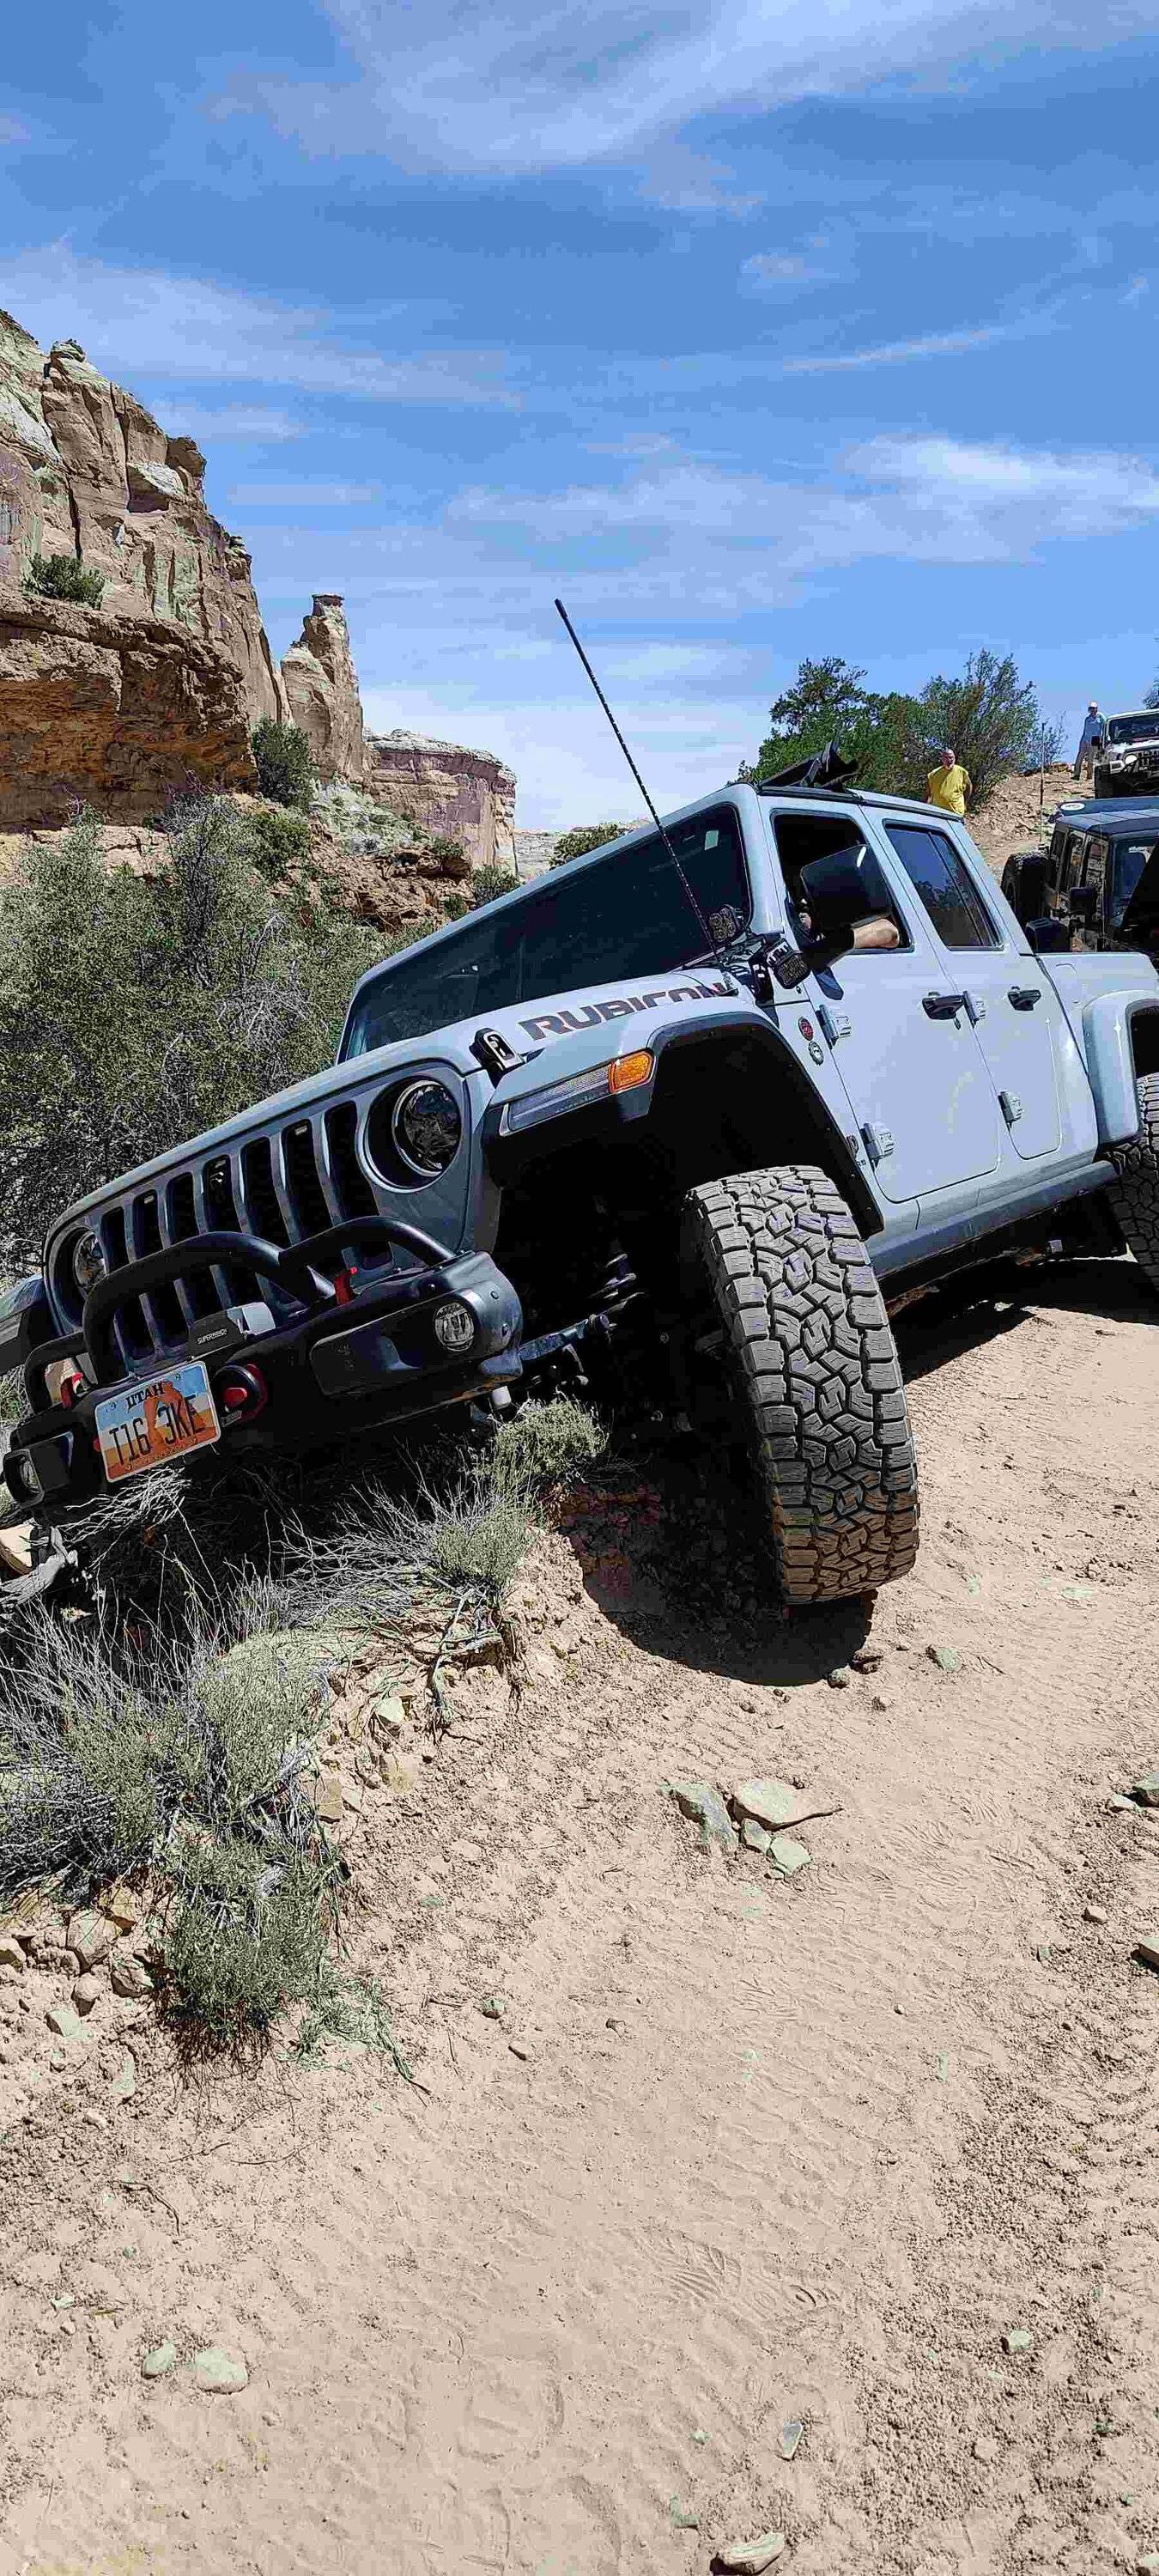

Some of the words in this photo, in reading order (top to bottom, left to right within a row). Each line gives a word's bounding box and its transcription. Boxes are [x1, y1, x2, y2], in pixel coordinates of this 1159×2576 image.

[518, 983, 727, 1041] RUBICON
[197, 1328, 227, 1344] SUPER
[125, 1381, 166, 1409] UTAH
